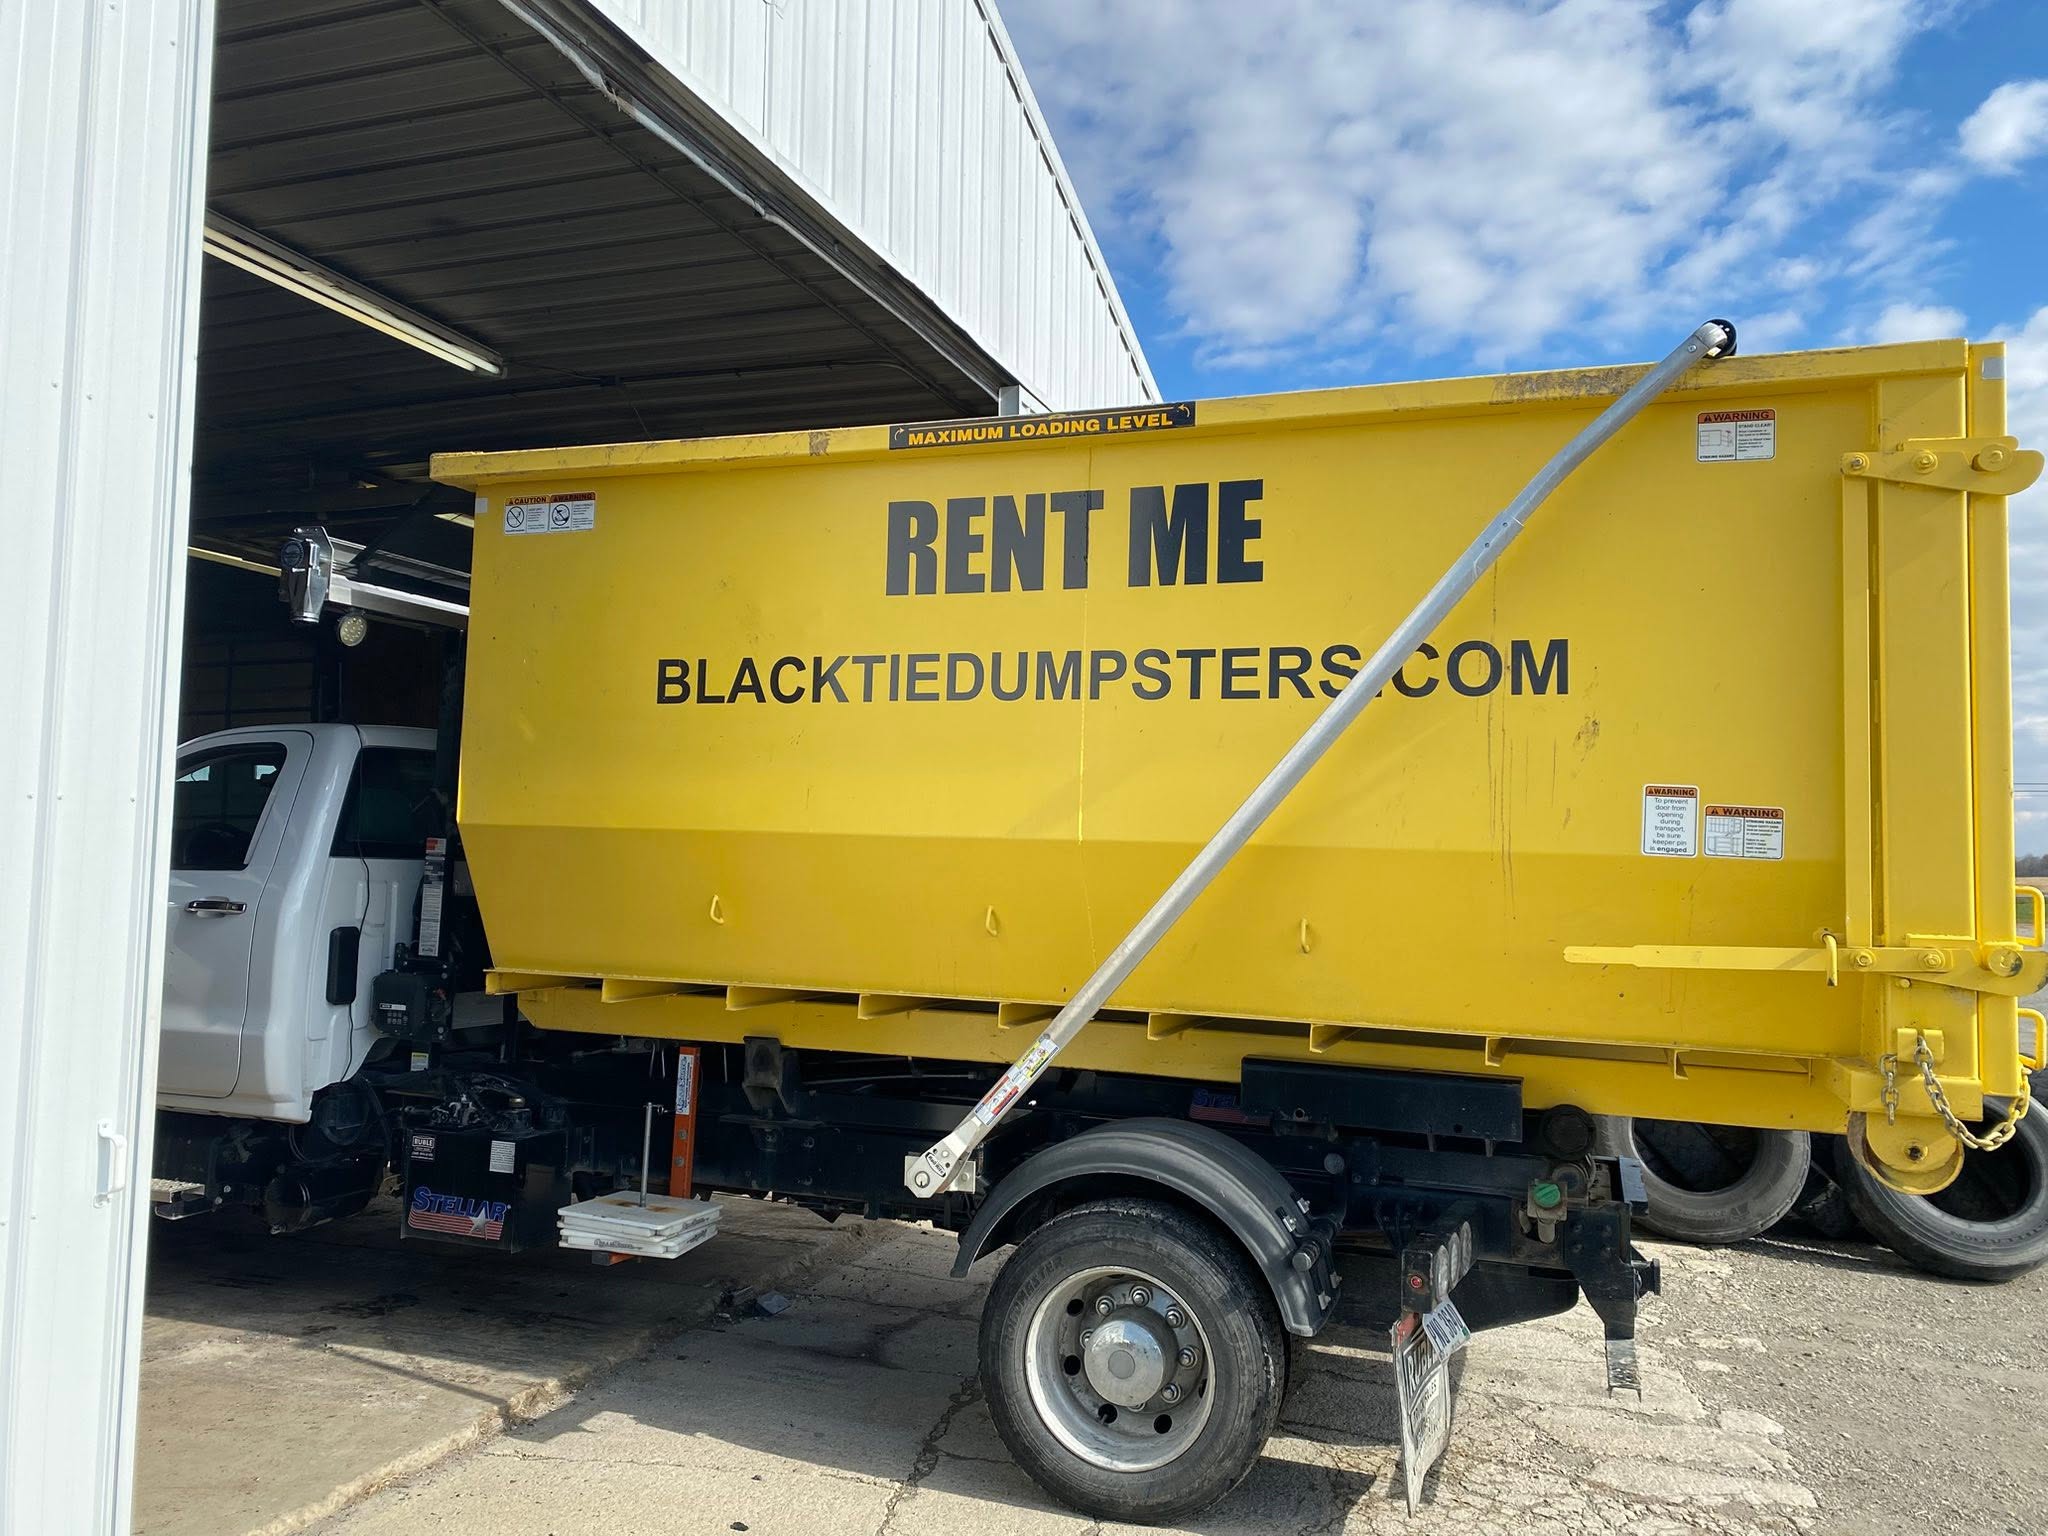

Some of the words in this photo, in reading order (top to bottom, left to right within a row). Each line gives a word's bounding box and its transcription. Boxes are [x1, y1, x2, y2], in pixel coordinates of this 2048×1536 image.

[1713, 411, 1769, 421] WARNING
[908, 426, 1003, 446] MAXIMUM
[1010, 419, 1100, 438] LOADING
[1107, 413, 1173, 430] LEVEL
[514, 496, 547, 505] CAUTION
[886, 490, 1104, 595] RENT
[1128, 479, 1263, 588] ME
[656, 639, 1569, 705] BLACKTIEDUMPSTERSCOM
[1655, 788, 1695, 796] WARNING
[1723, 808, 1779, 818] WARNING
[412, 1186, 507, 1222] STELLAR
